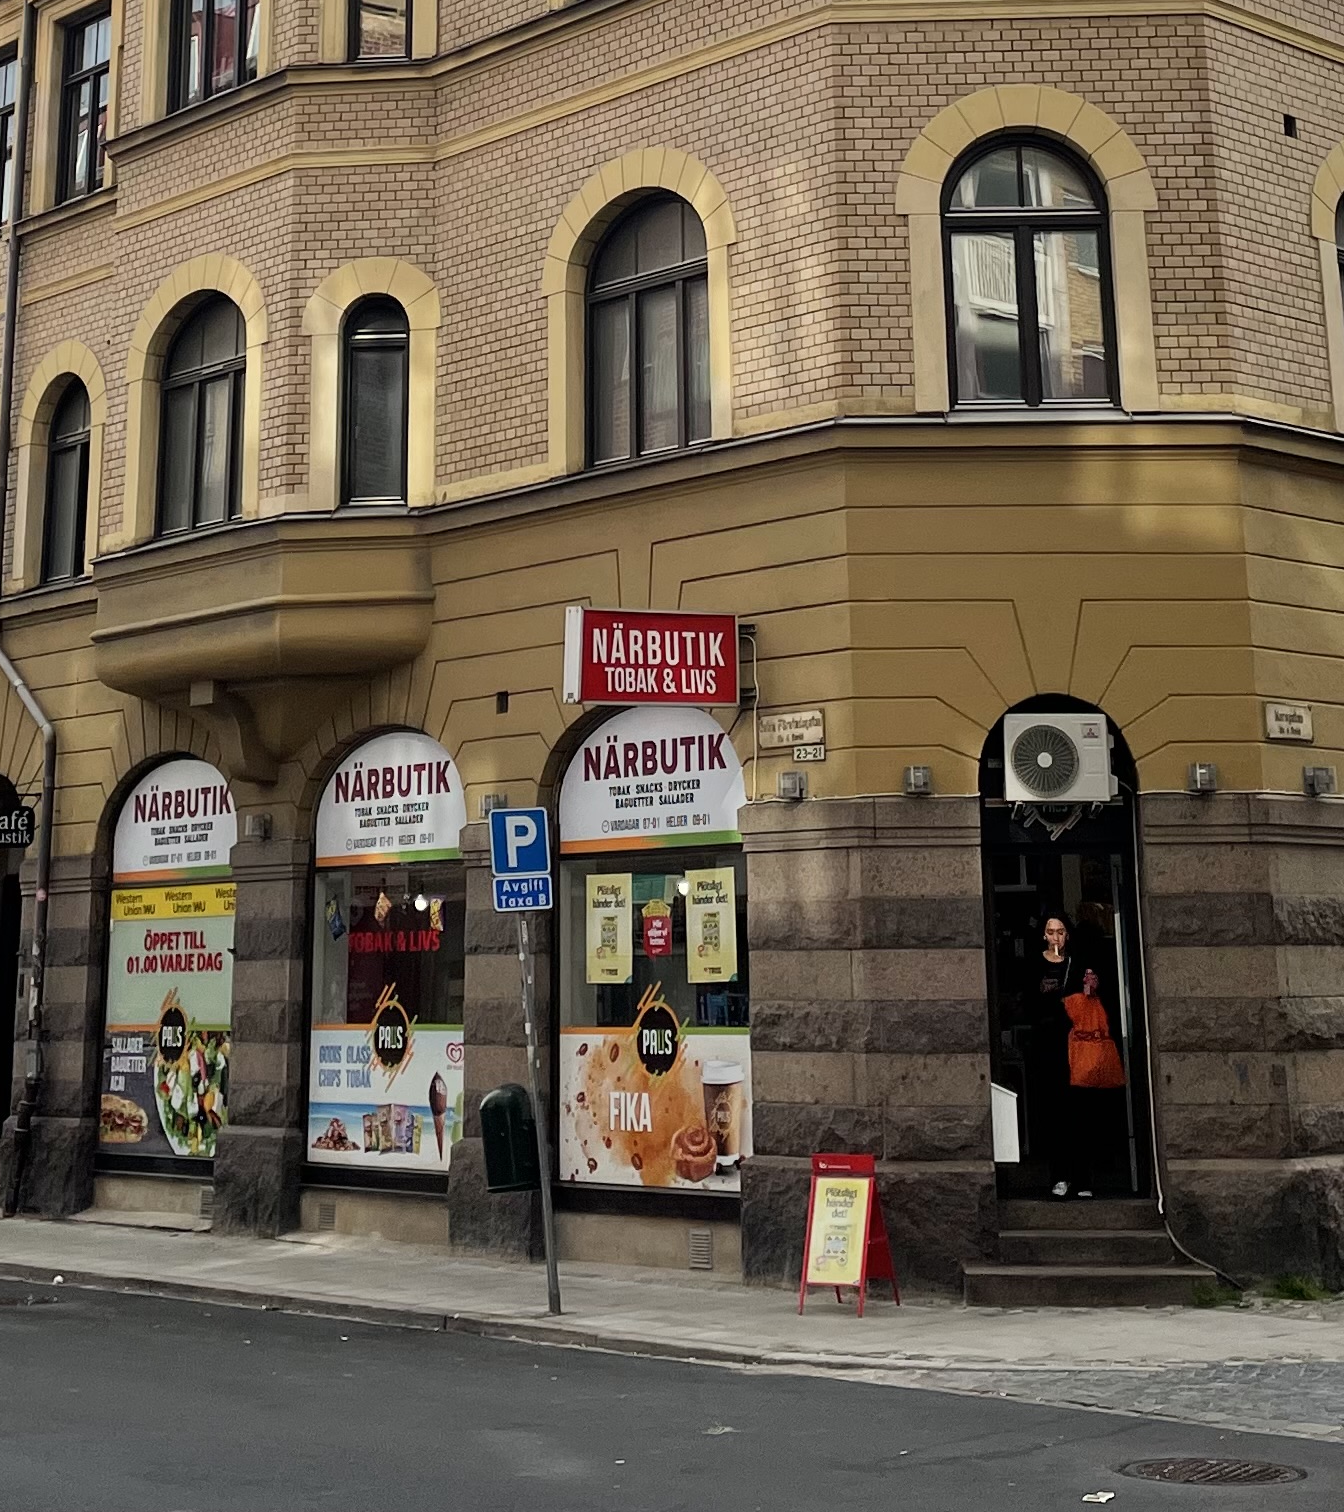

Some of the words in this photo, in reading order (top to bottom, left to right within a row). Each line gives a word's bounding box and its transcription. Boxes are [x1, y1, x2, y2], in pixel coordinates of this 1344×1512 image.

[592, 623, 725, 667] NÄRBUTIK
[605, 667, 658, 693] TOBAK
[663, 669, 677, 693] &
[682, 669, 716, 695] LIVS
[584, 733, 727, 781] NÄRBUTIK
[334, 760, 450, 804] NÄRBUTIK
[609, 785, 630, 797] TOBAK
[636, 782, 663, 794] SNACKS
[668, 779, 700, 791] DRYCKER
[134, 785, 232, 823] NÄRBUTIK
[615, 796, 653, 809] BAGUETTER
[659, 793, 694, 805] SALLADER
[505, 815, 537, 867] P
[502, 879, 543, 894] Avgift
[116, 894, 143, 904] Western
[164, 891, 192, 901] Western
[501, 895, 533, 908] Taxa
[539, 895, 546, 906] B
[123, 904, 142, 916] Union
[172, 901, 191, 913] Union
[144, 930, 183, 951] ÖPPET
[183, 931, 206, 949] TILL
[348, 931, 393, 952] TOBAK
[396, 932, 405, 952] &
[409, 930, 441, 952] LIVS
[127, 956, 157, 974] 01.00
[160, 953, 194, 972] VARJE
[197, 952, 223, 971] DAG
[112, 1037, 144, 1054] SALLADER
[319, 1045, 342, 1064] GODIS
[346, 1046, 371, 1064] GLASS
[111, 1056, 146, 1073] BAGUETTER
[319, 1069, 341, 1088] CHIPS
[346, 1069, 371, 1088] TOBAK
[609, 1092, 652, 1133] FIKA
[825, 1187, 858, 1199] Plötsligt
[826, 1198, 854, 1209] händer
[832, 1208, 847, 1218] det!
